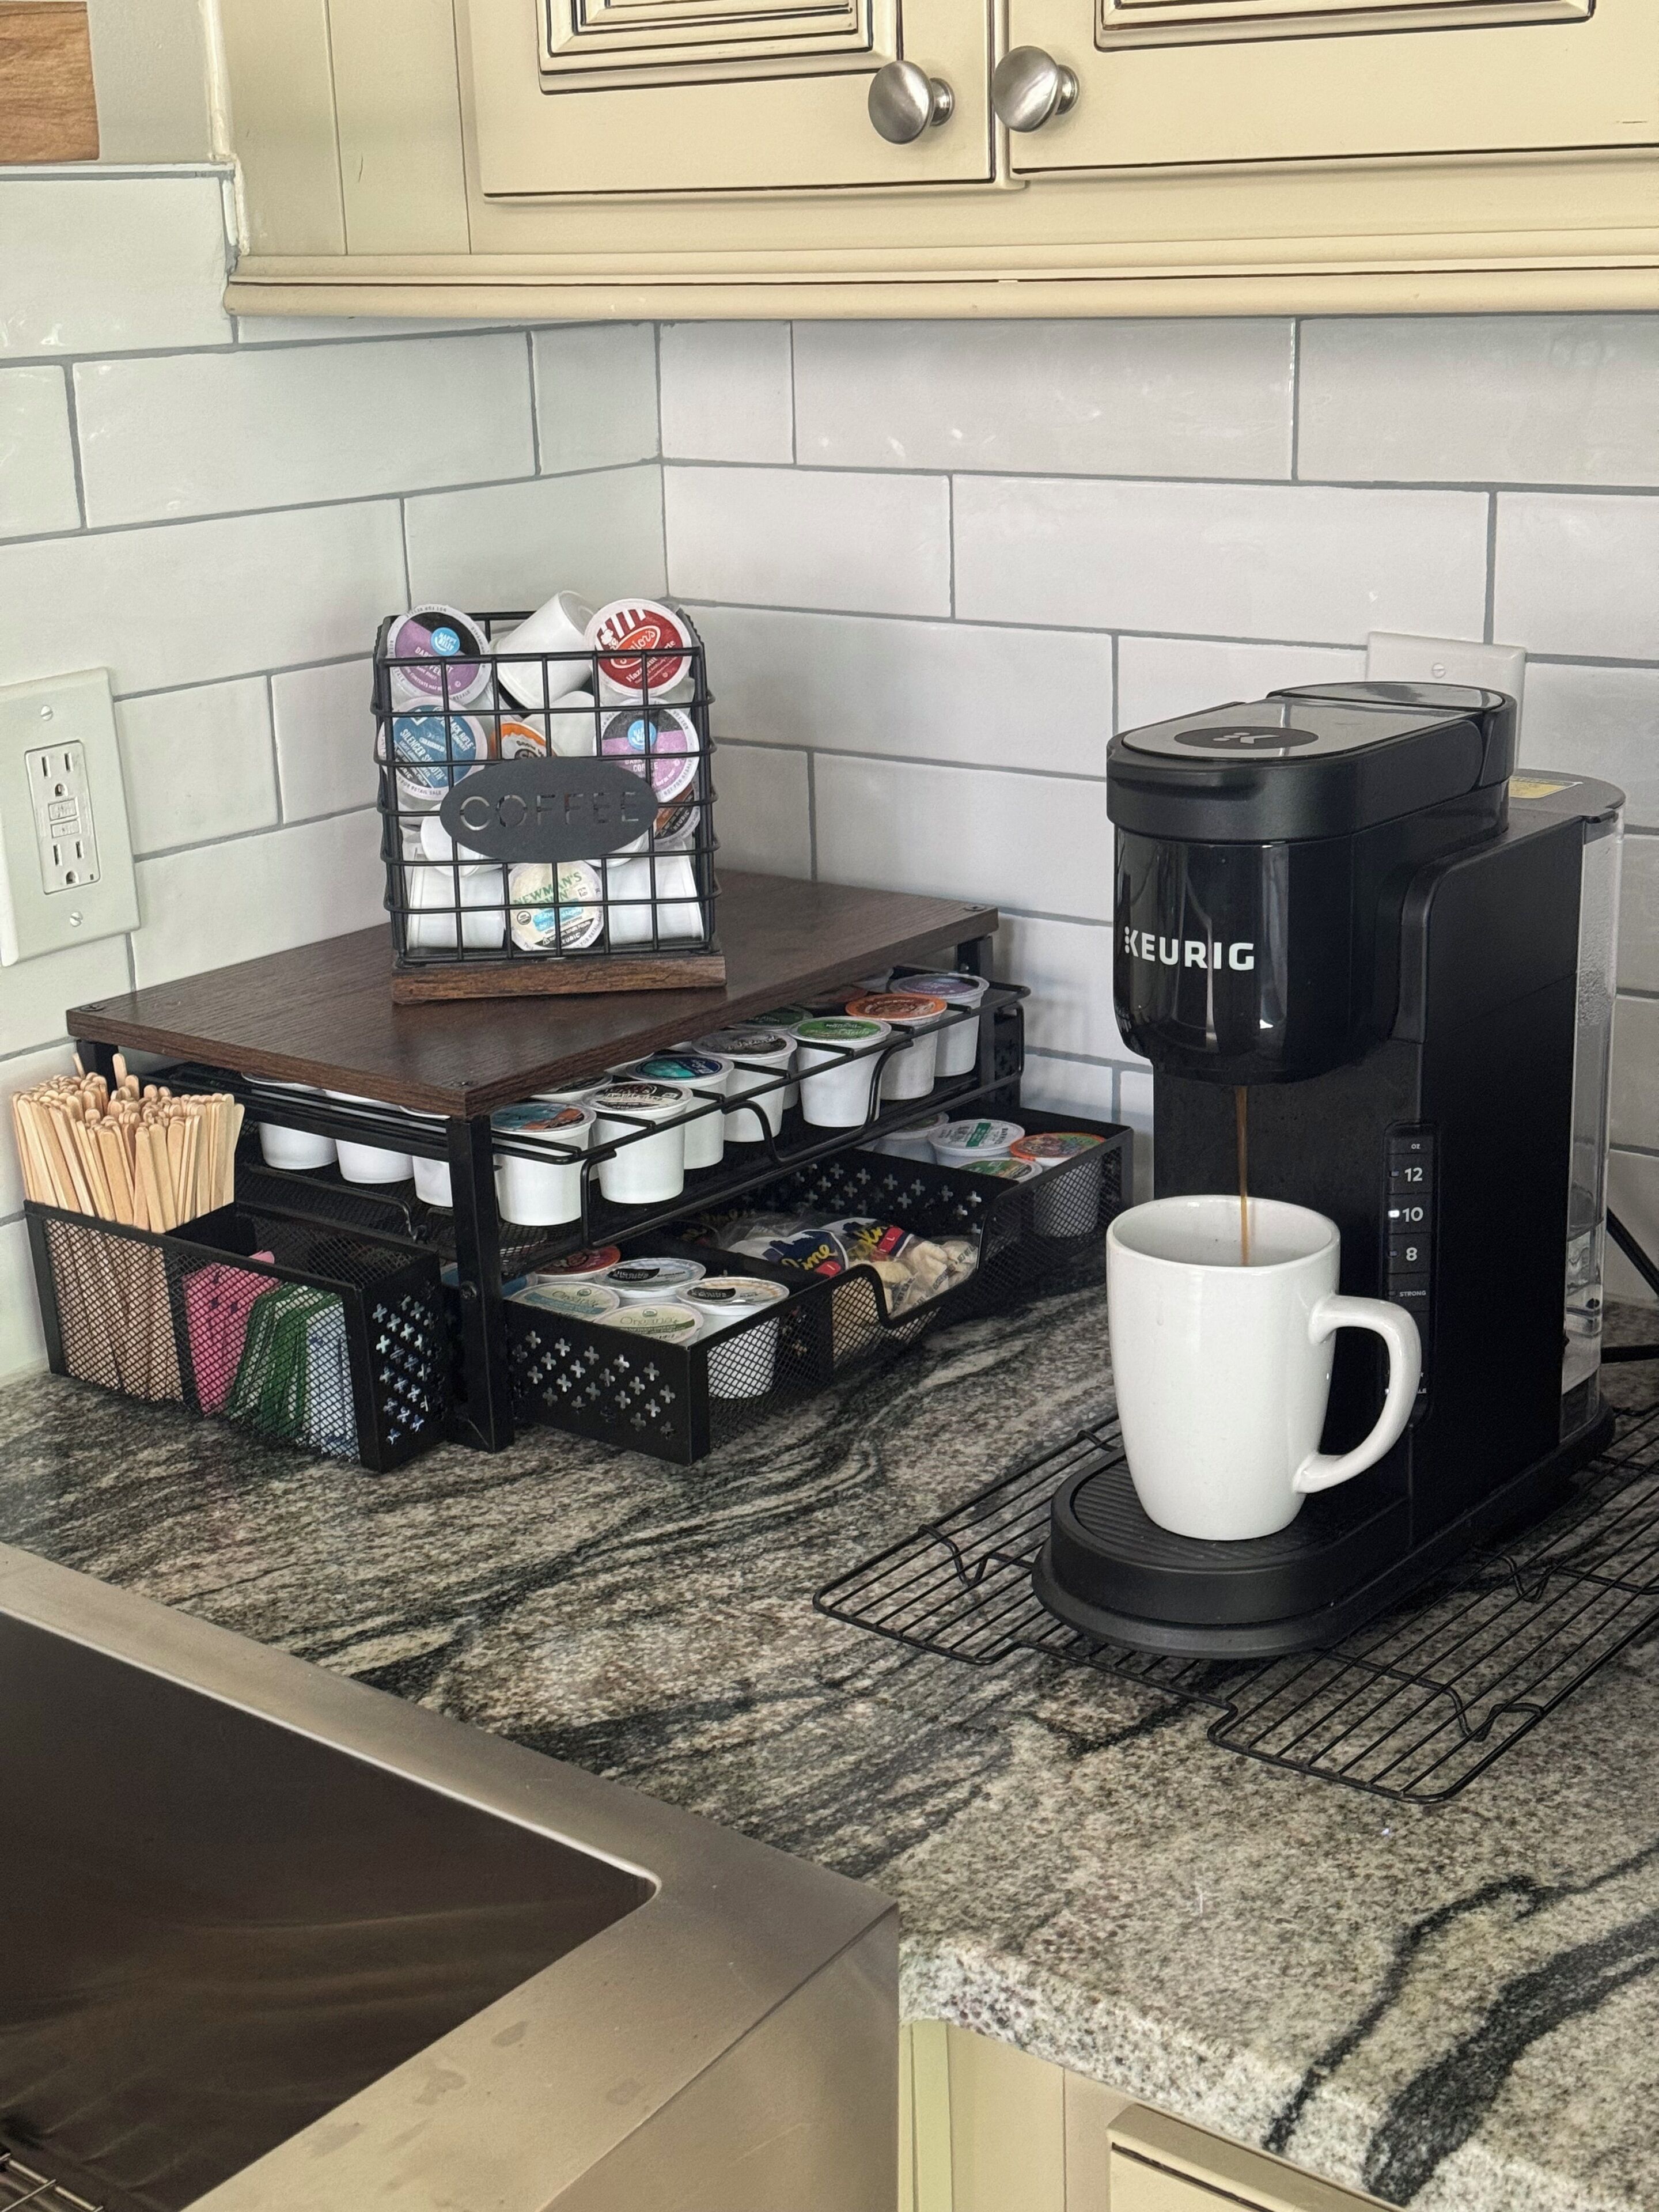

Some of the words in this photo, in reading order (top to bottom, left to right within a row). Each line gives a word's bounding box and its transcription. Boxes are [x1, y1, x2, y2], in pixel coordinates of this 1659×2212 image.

[400, 728, 426, 757] SILENCER
[460, 791, 639, 831] COFFEE
[1124, 926, 1255, 971] KEURIG
[1404, 1167, 1423, 1182] 12
[1402, 1207, 1423, 1223] 10
[1406, 1247, 1418, 1262] 8
